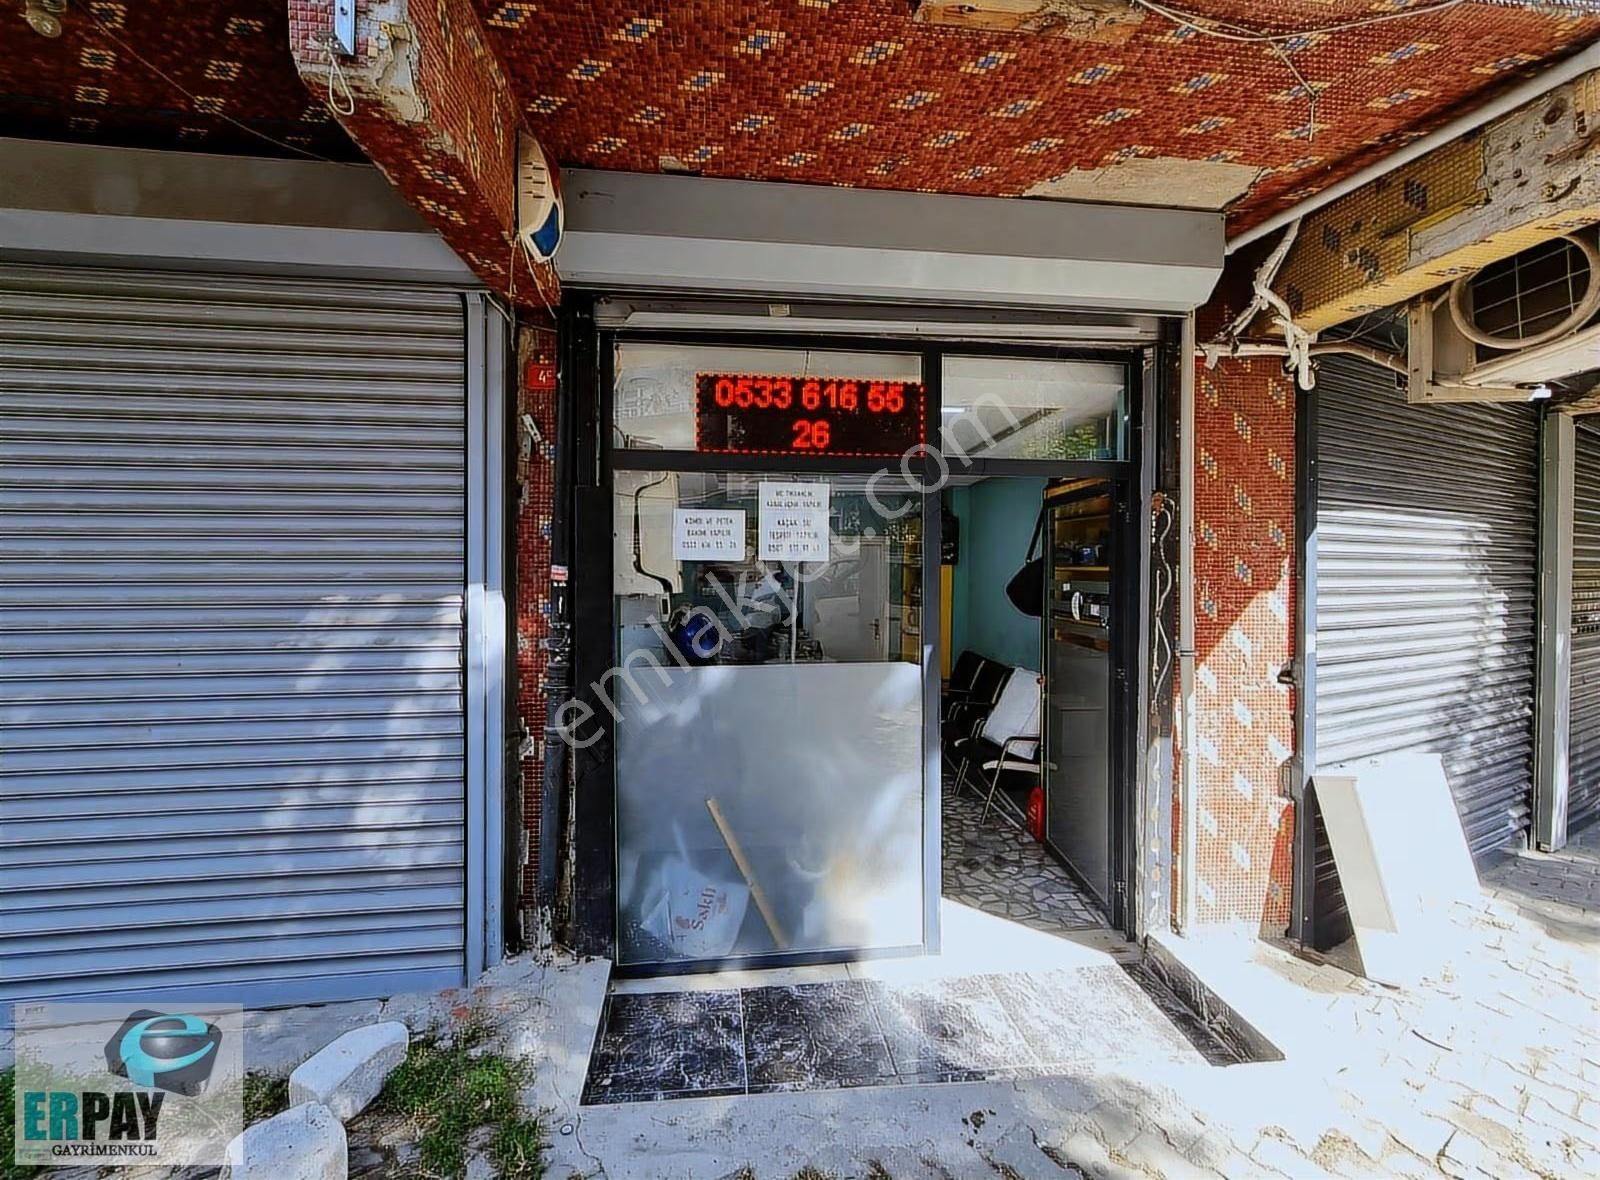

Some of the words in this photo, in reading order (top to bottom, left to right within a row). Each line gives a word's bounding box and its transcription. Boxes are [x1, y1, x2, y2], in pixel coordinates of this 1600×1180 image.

[715, 380, 792, 408] 0533
[802, 382, 857, 411] 616
[867, 385, 904, 412] 55
[792, 420, 830, 449] 26
